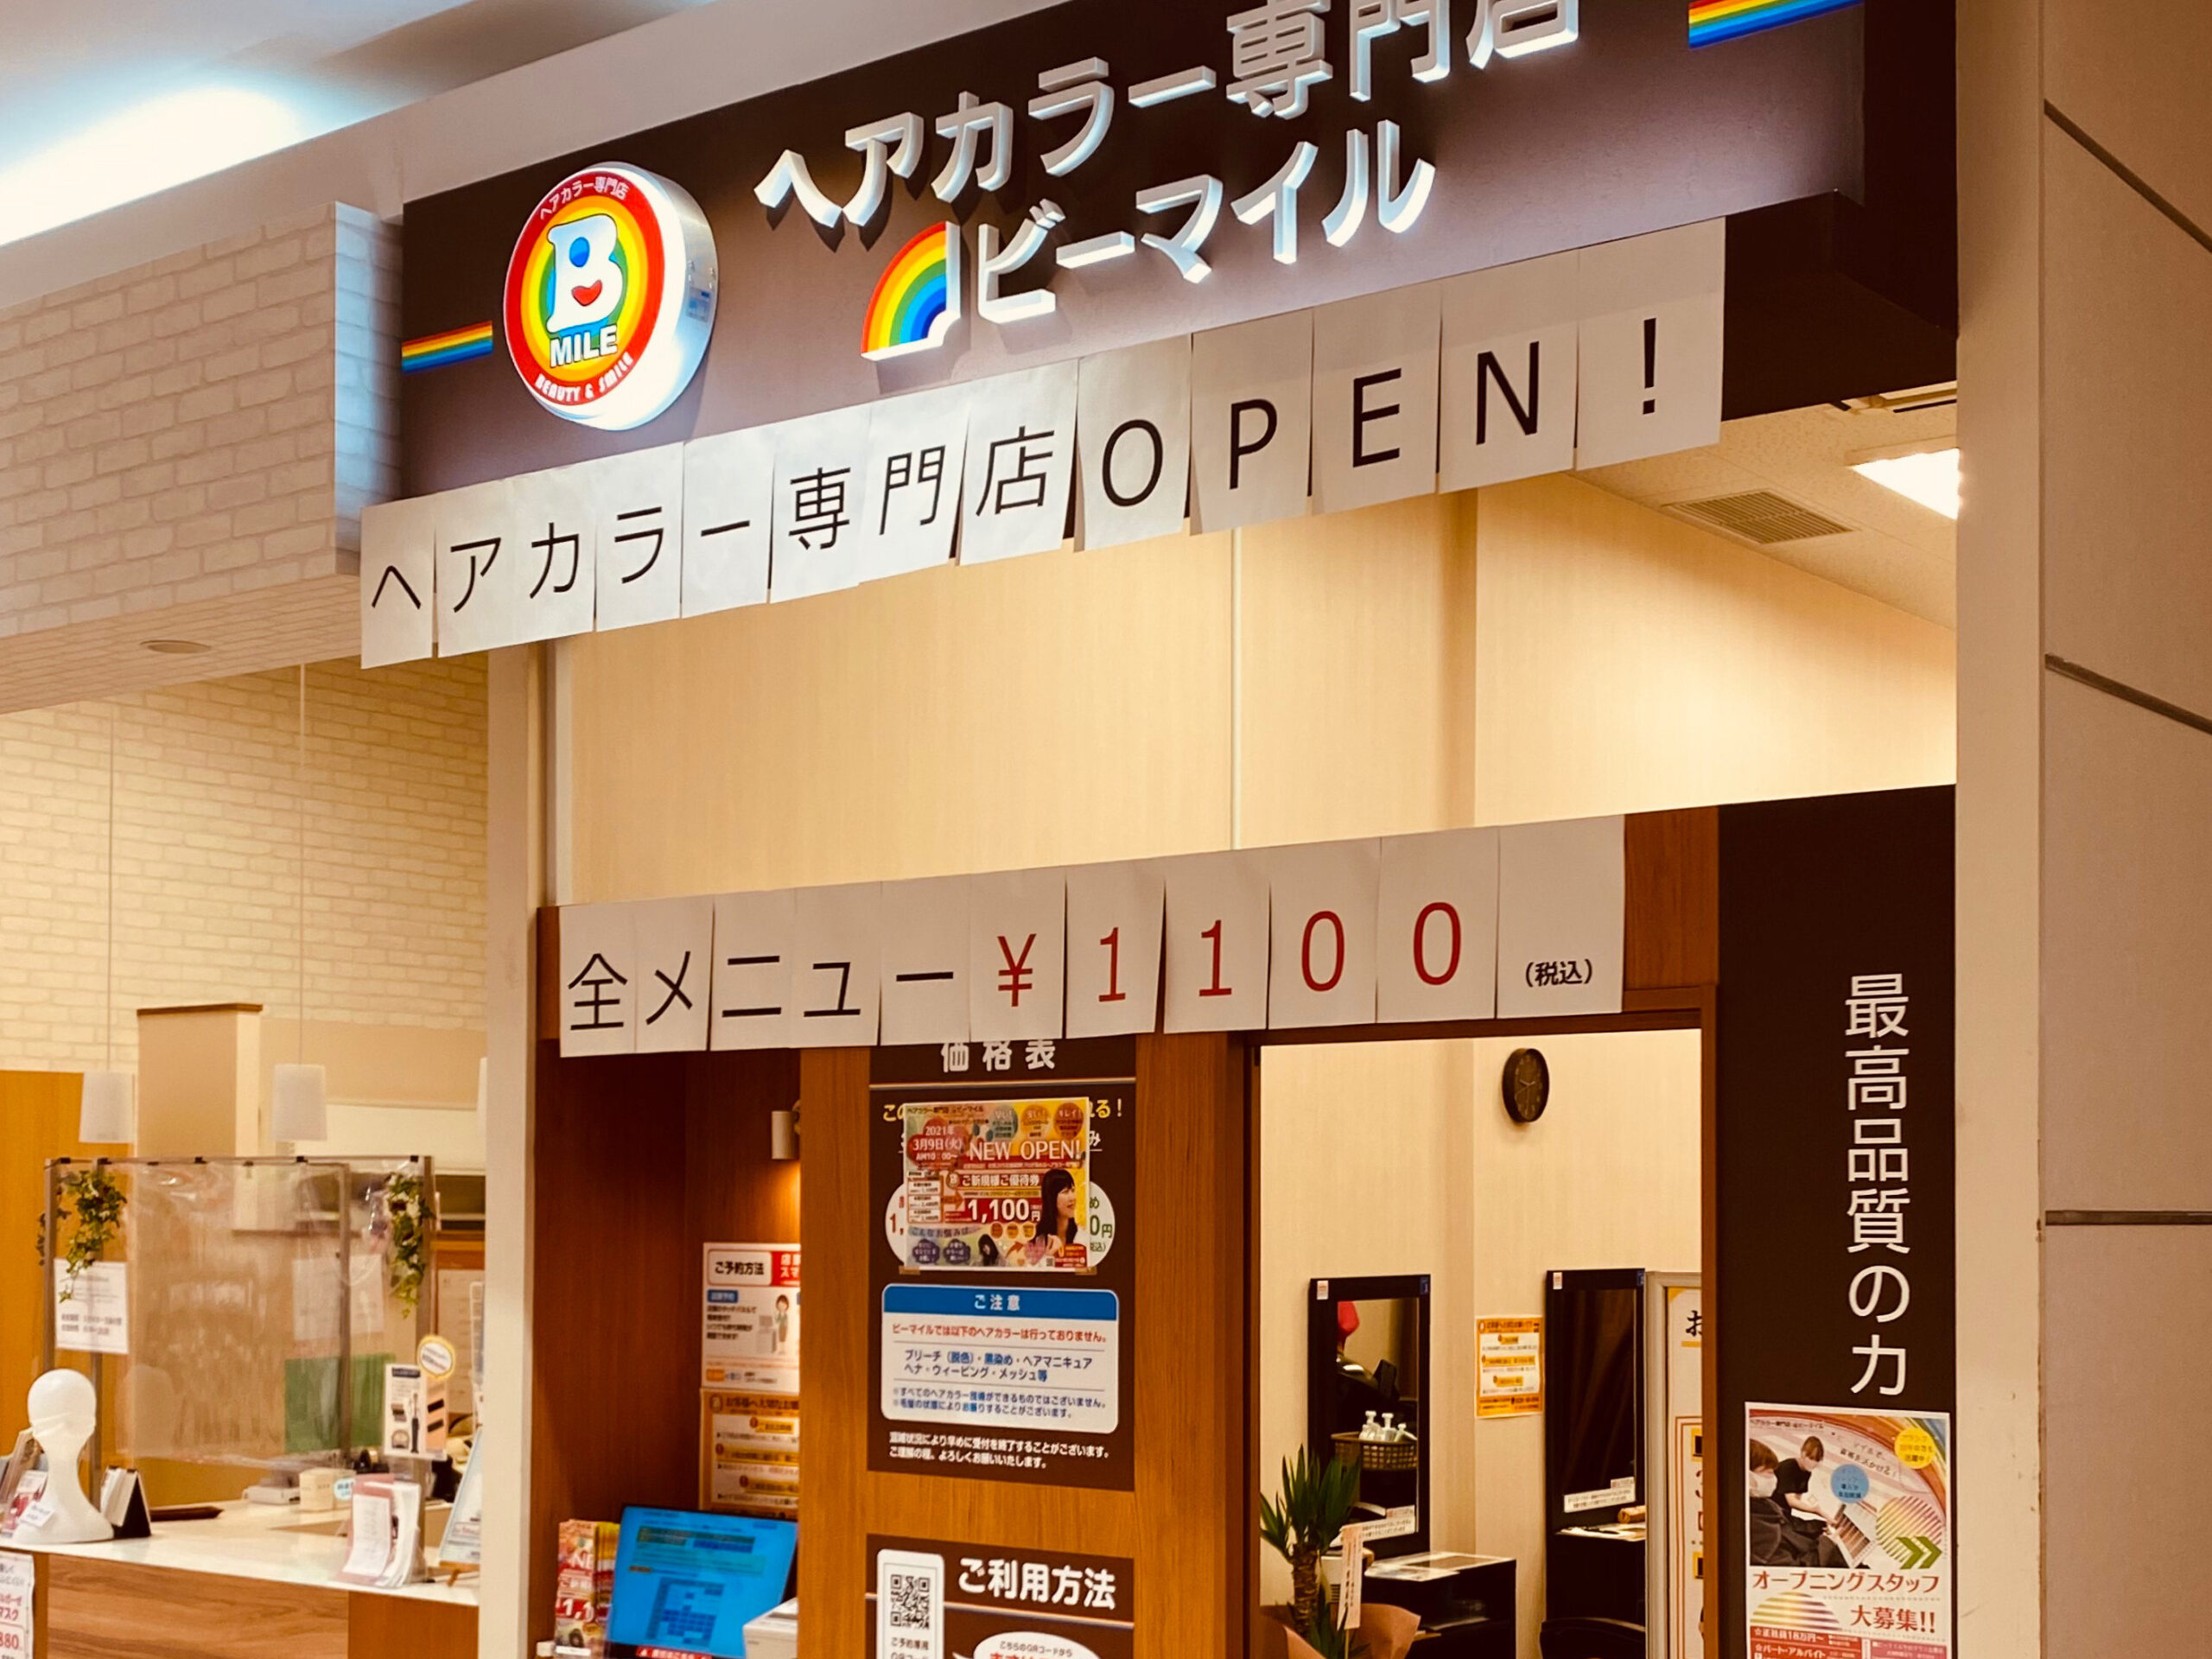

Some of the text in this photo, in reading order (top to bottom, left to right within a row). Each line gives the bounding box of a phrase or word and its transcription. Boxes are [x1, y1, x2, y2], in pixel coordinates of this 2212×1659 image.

[753, 0, 1580, 230] ヘアカラー専門店
[539, 175, 630, 220] ヘアカラー専門店
[978, 118, 1436, 324] ビーマイル
[549, 324, 619, 368] MILE
[534, 372, 582, 403] BEAUTY
[940, 1039, 1056, 1073] 価格表
[969, 1139, 1081, 1161] NEW OPEN!
[974, 1294, 1021, 1312] ご注意
[958, 1557, 1116, 1610] ご利用方法
[1752, 1570, 1940, 1593] オープニングスタッフ
